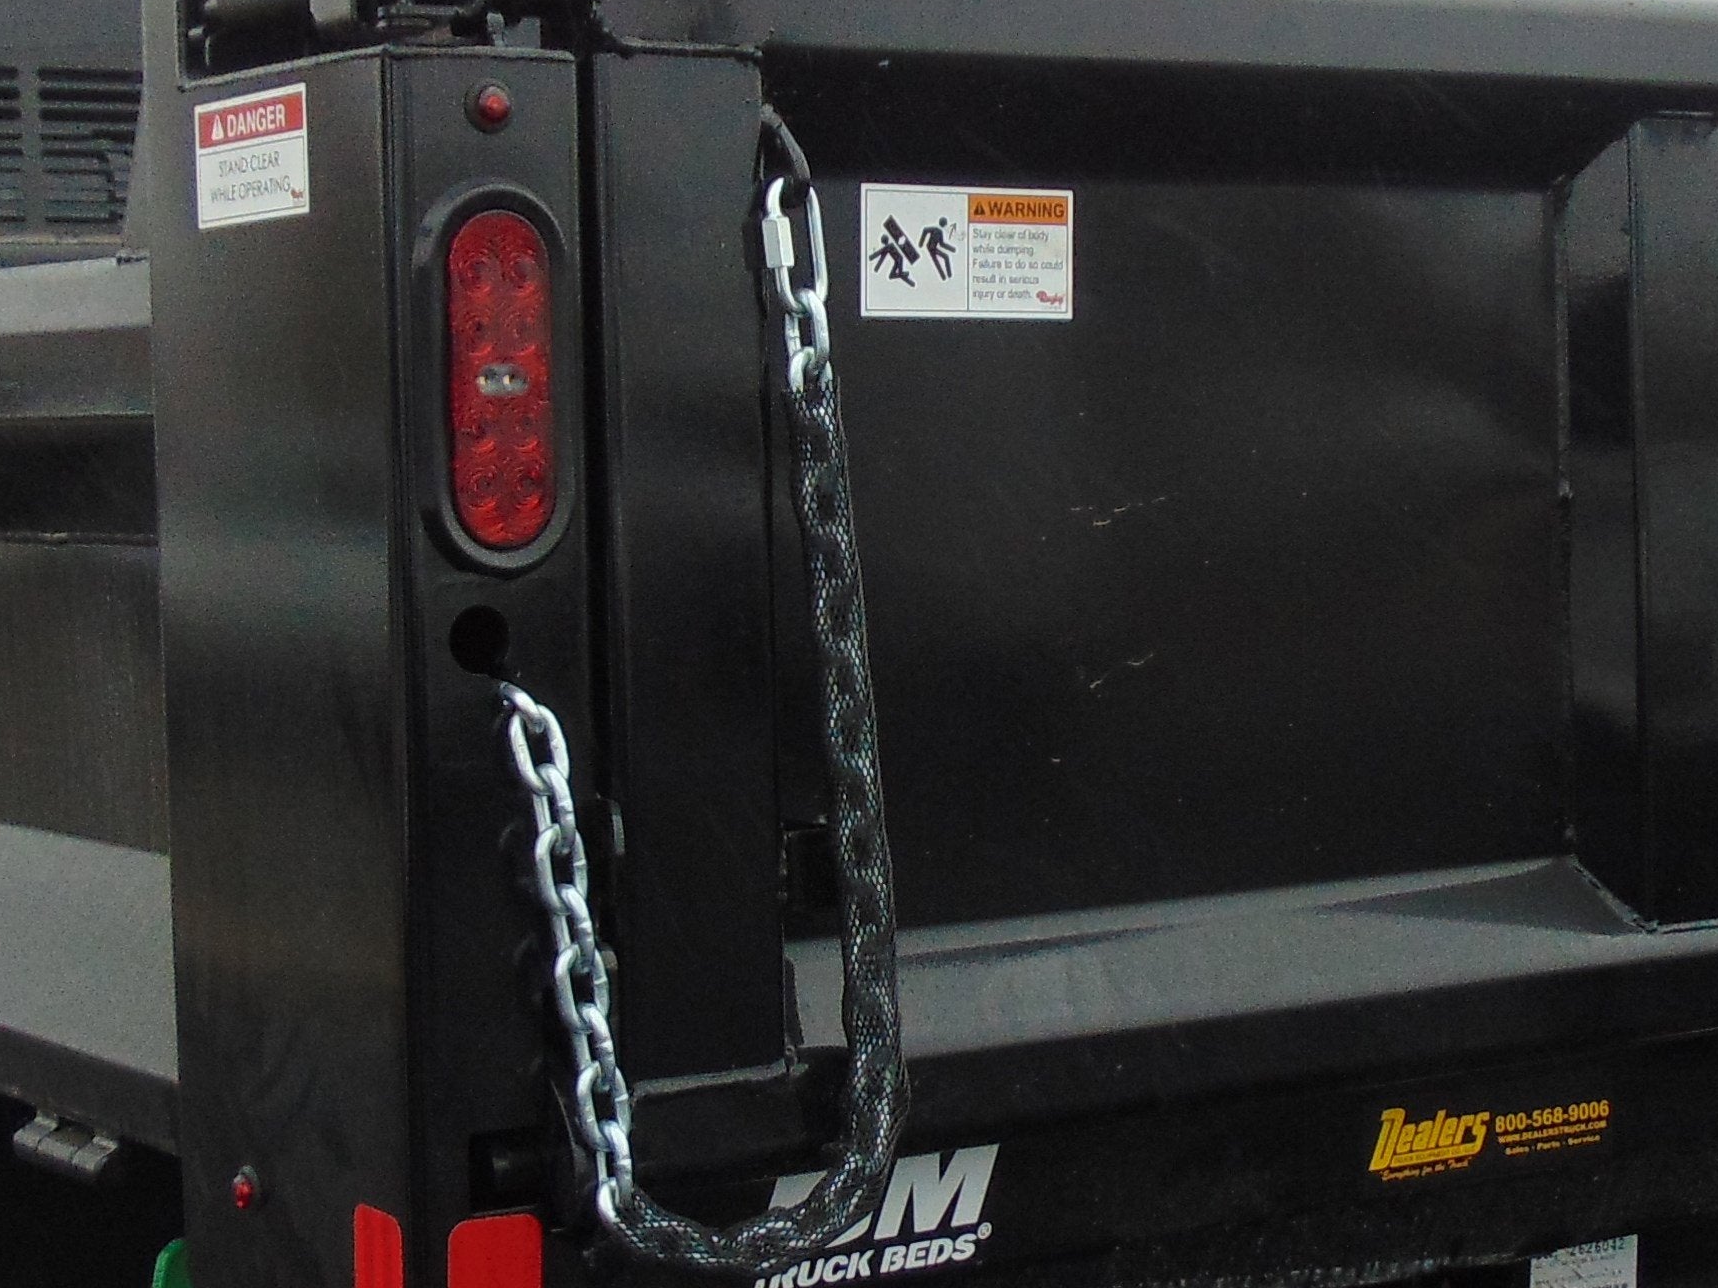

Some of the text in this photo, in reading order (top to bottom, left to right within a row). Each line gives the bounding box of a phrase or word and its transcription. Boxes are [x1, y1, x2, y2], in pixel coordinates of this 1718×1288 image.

[226, 103, 286, 138] DANGER
[218, 150, 281, 177] STAND CLEAR
[210, 184, 236, 203] WHILE
[238, 175, 291, 200] OPERATING
[988, 201, 1065, 218] WARNING
[972, 228, 1050, 242] Stay clear of body
[972, 243, 995, 254] while
[972, 258, 1064, 270] Failure to do so could
[972, 274, 1040, 285] result in serious
[972, 289, 994, 301] injury
[996, 290, 1006, 299] or
[1495, 1099, 1610, 1133] 800-568-9006
[1368, 1107, 1491, 1172] Dealers
[1497, 1119, 1608, 1144] WWW.DEALERSTRUCK.COM
[879, 1232, 979, 1274] BEDS
